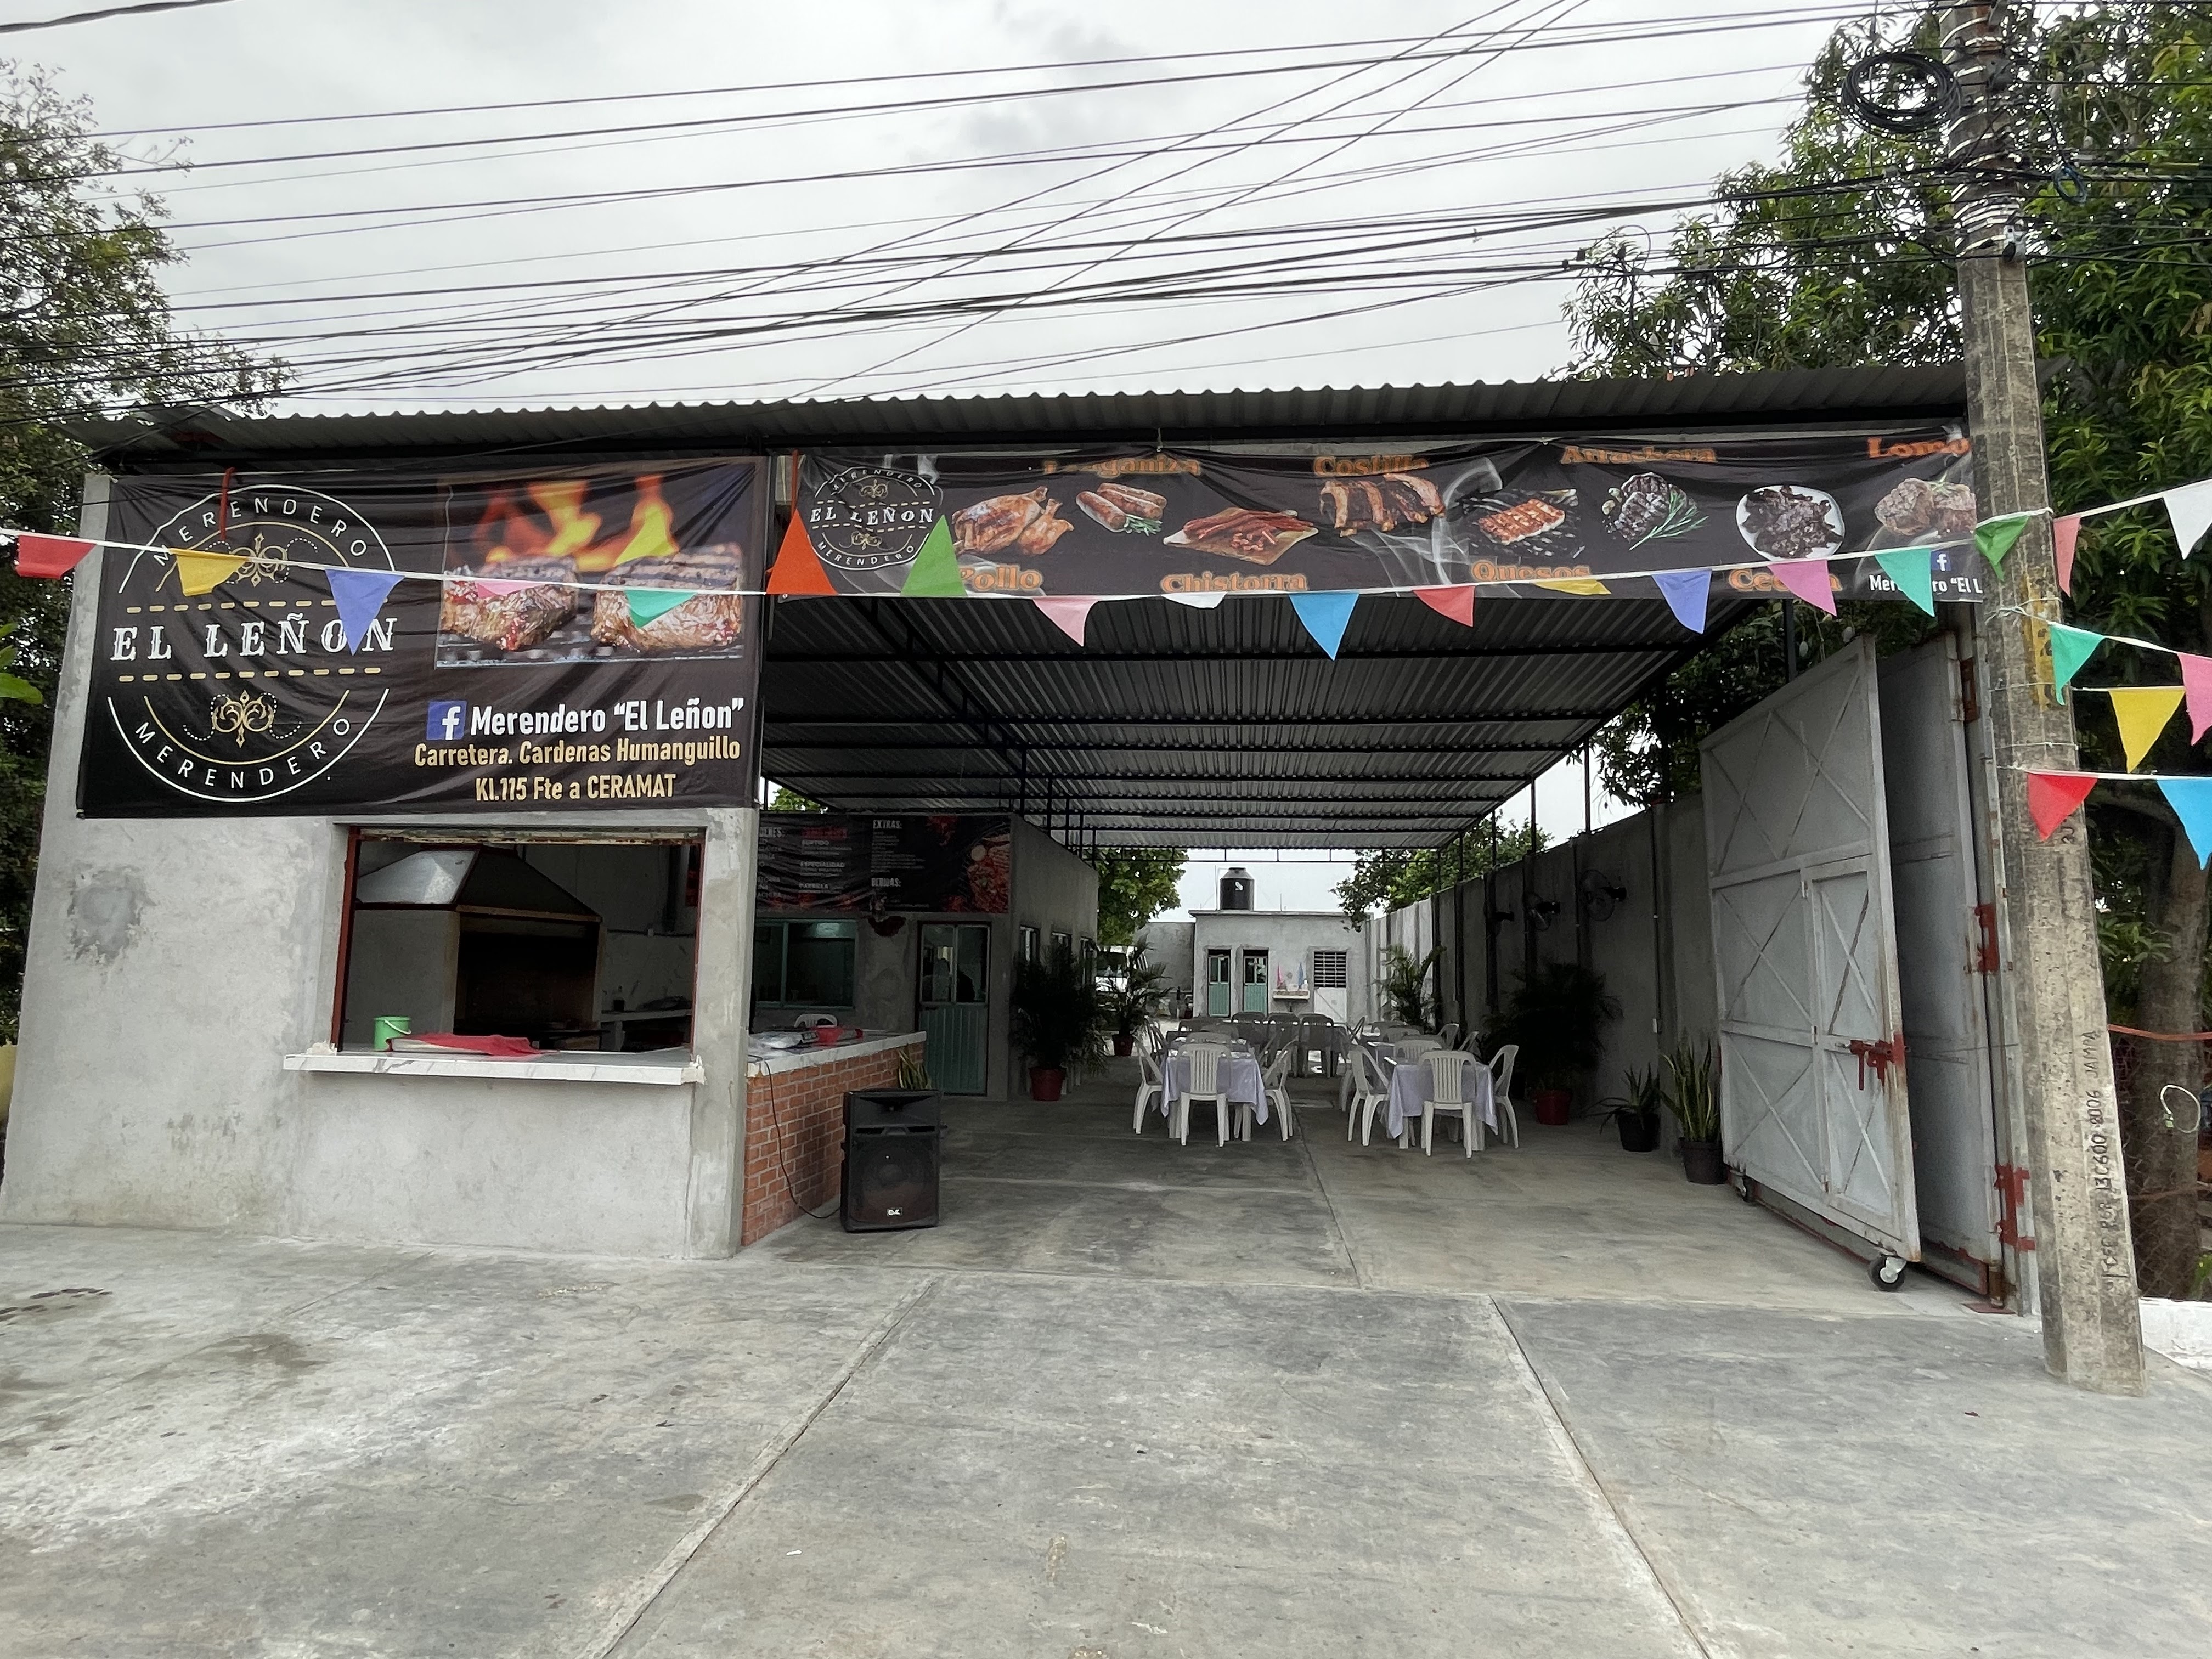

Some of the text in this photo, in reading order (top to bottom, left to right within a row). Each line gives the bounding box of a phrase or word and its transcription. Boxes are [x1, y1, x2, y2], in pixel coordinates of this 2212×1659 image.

[810, 507, 836, 522] EL
[154, 497, 367, 566] MERENDERO
[817, 541, 914, 565] MERENDERO
[1160, 571, 1307, 592] Chistorra
[1472, 560, 1590, 582] Quesos
[110, 612, 398, 662] EL LEÑON
[470, 703, 606, 736] Merendero
[135, 718, 351, 789] MERENDERO
[415, 736, 741, 766] Carretera. Cardenas Humanguillo
[533, 776, 562, 800] Fte
[569, 781, 580, 799] a
[587, 774, 676, 799] CERAMAT
